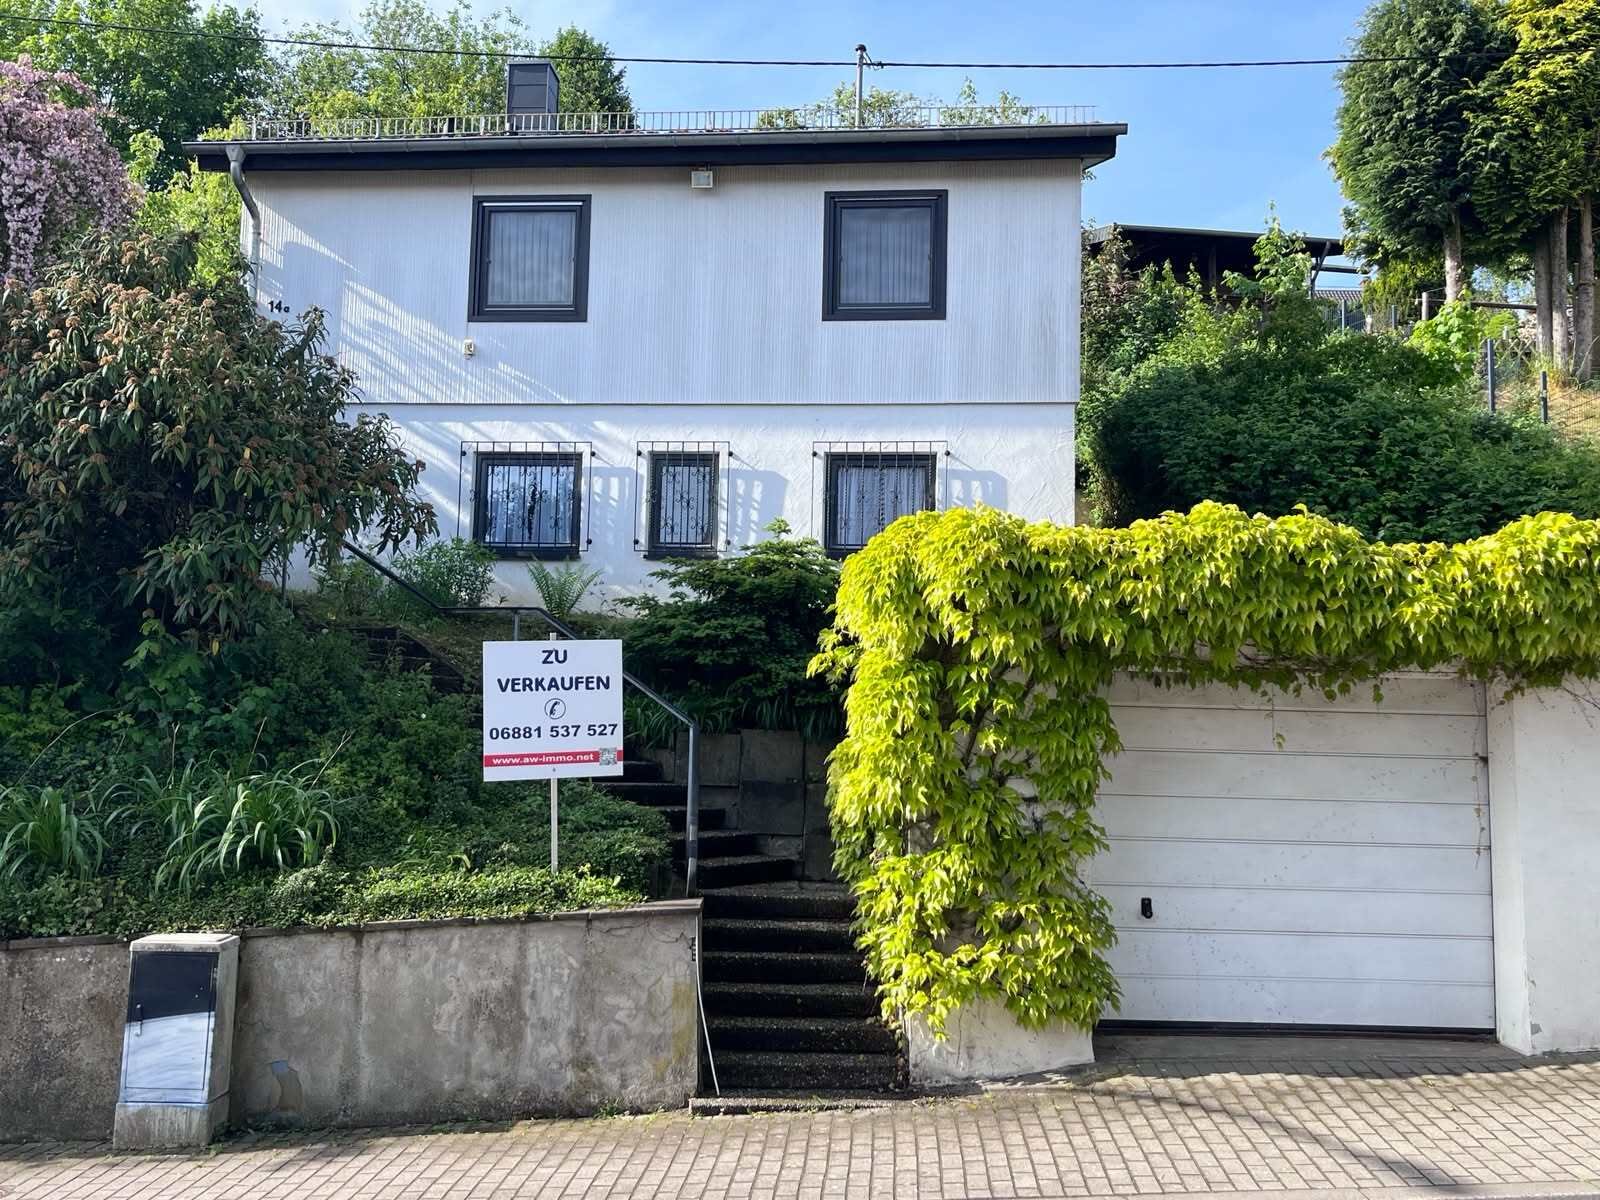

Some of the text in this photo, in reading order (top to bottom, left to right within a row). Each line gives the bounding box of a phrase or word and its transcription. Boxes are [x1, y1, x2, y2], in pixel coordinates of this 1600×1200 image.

[542, 649, 568, 664] ZU
[497, 675, 610, 692] VERKAUFEN
[489, 723, 618, 740] 06881 537 527
[492, 753, 594, 765] www.aw-immo.net
